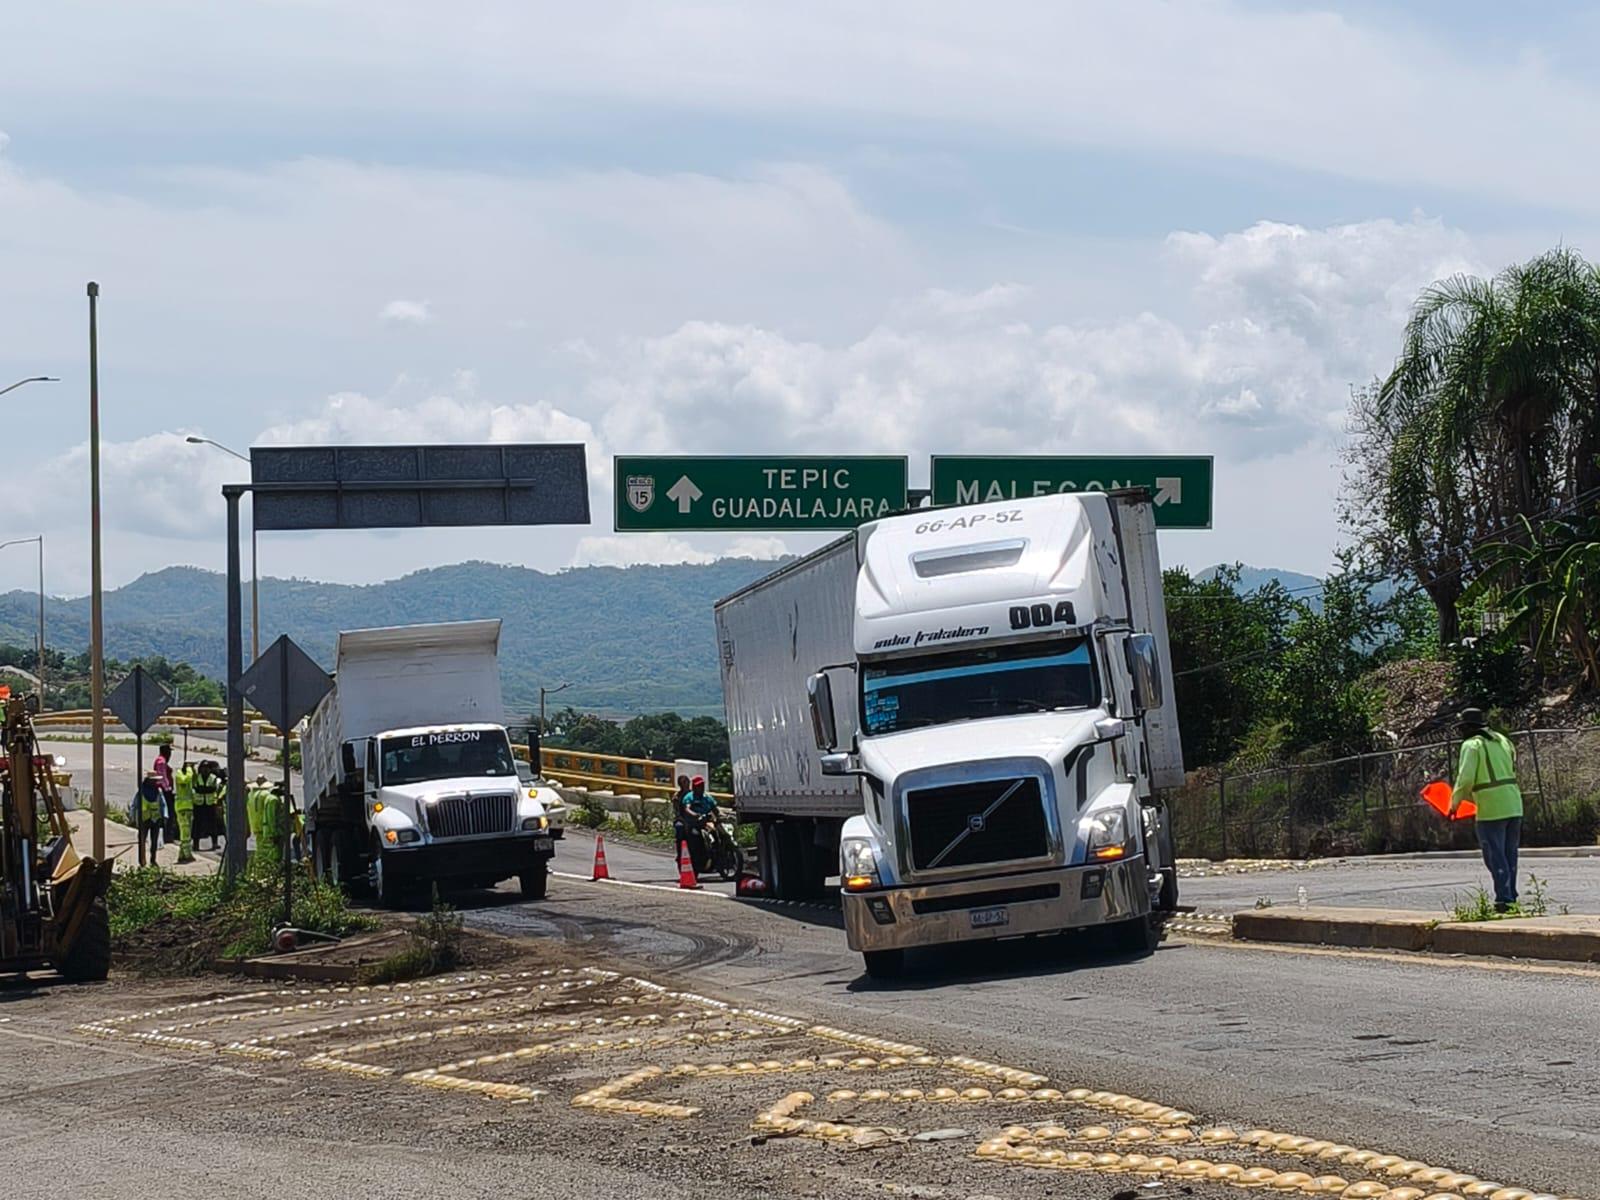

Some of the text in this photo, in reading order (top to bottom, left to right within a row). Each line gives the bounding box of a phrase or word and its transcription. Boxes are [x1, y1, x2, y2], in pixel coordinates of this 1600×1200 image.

[762, 469, 850, 489] TEPIC
[634, 490, 649, 505] 15
[711, 498, 890, 518] GUADALAJARA
[914, 509, 1024, 535] 66-AP-5Z
[1009, 601, 1076, 630] 004
[411, 731, 481, 747] EL PERRON
